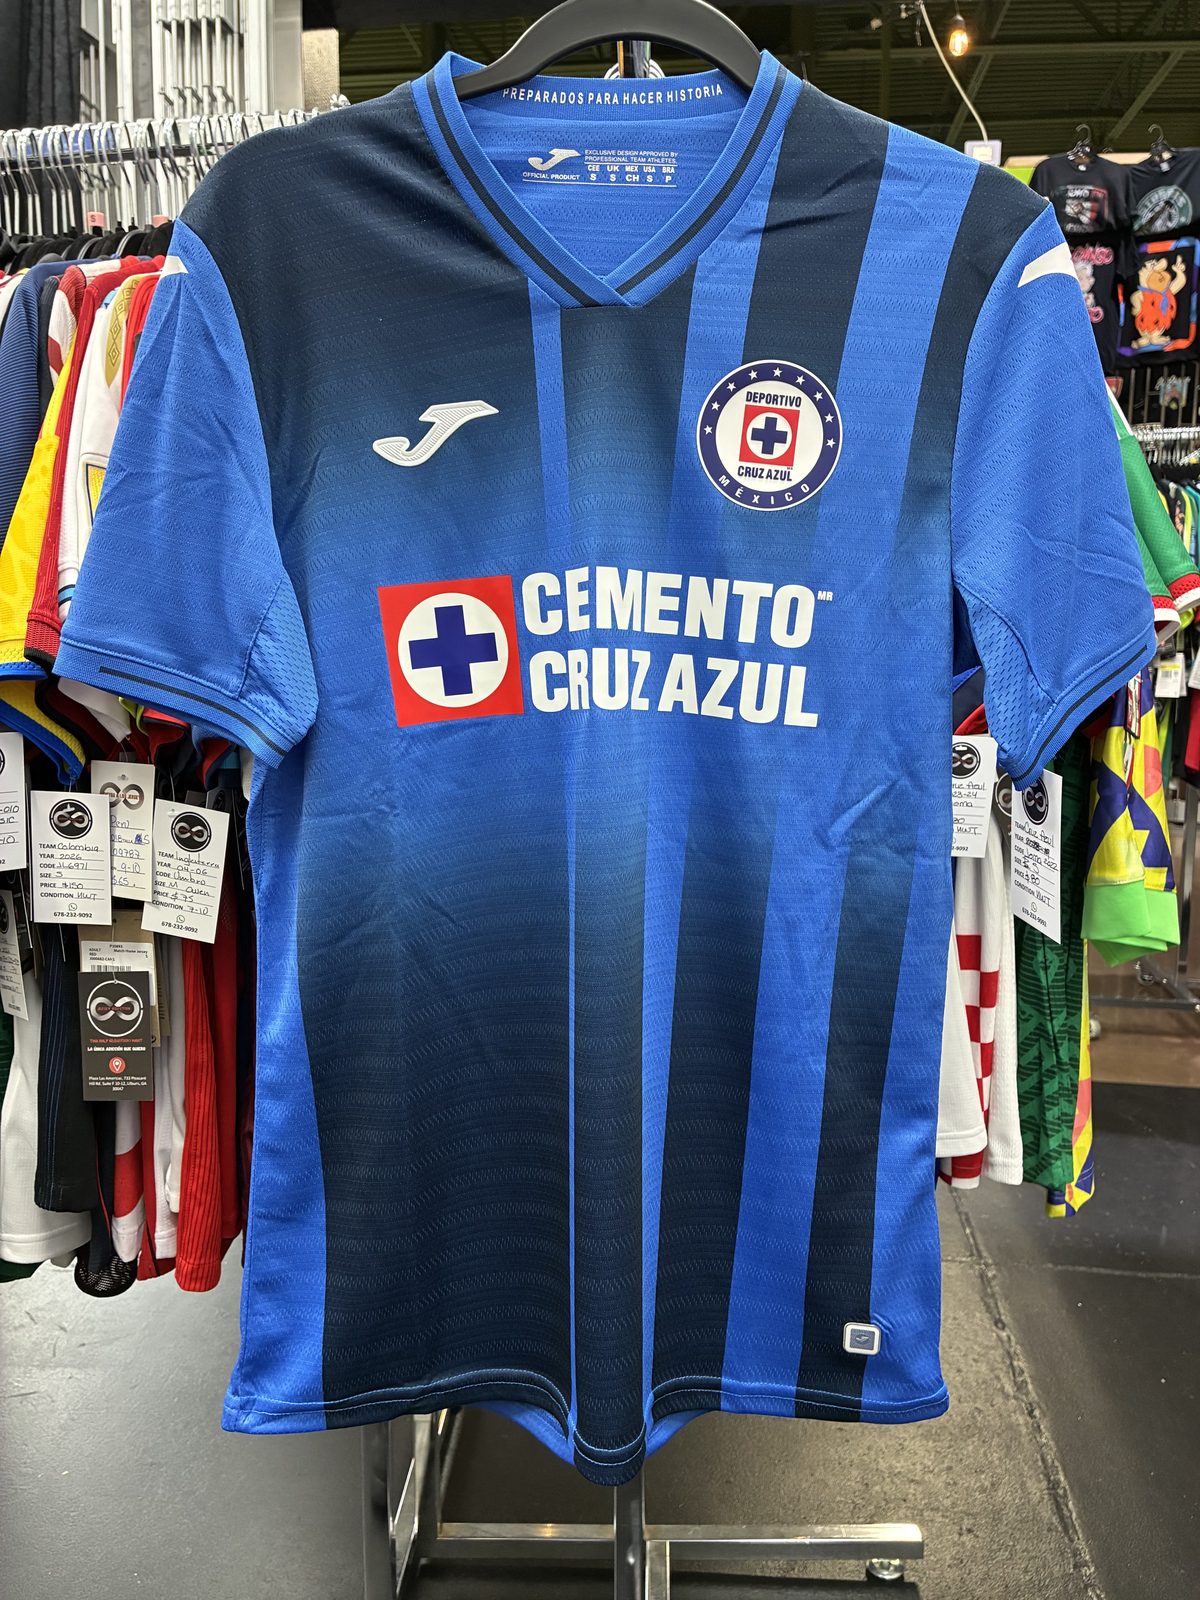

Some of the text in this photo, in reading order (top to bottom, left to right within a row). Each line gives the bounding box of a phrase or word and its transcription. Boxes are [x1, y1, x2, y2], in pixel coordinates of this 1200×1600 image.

[502, 83, 723, 105] PREPARADOS PARA HACER HISTORIA
[522, 171, 549, 179] OFFICIAL
[625, 165, 639, 173] MEX
[662, 166, 675, 174] BRA
[626, 174, 639, 182] CH
[665, 175, 672, 183] P
[745, 391, 802, 408] DEPORTIVO
[737, 465, 793, 482] CRUZ AZUL
[718, 474, 810, 505] MÉXICO
[521, 566, 833, 648] CEMENTO MR
[529, 647, 819, 728] CRUZ AZUL
[1014, 844, 1025, 854] CODE
[158, 851, 174, 859] TEAM
[155, 870, 171, 878] CODE
[177, 865, 208, 875] 04-06
[1014, 868, 1025, 879] PRICE
[1014, 879, 1035, 897] CONDITION
[153, 890, 169, 898] PRICE
[152, 899, 184, 911] CONDITION
[161, 921, 198, 933] 678-232-9092
